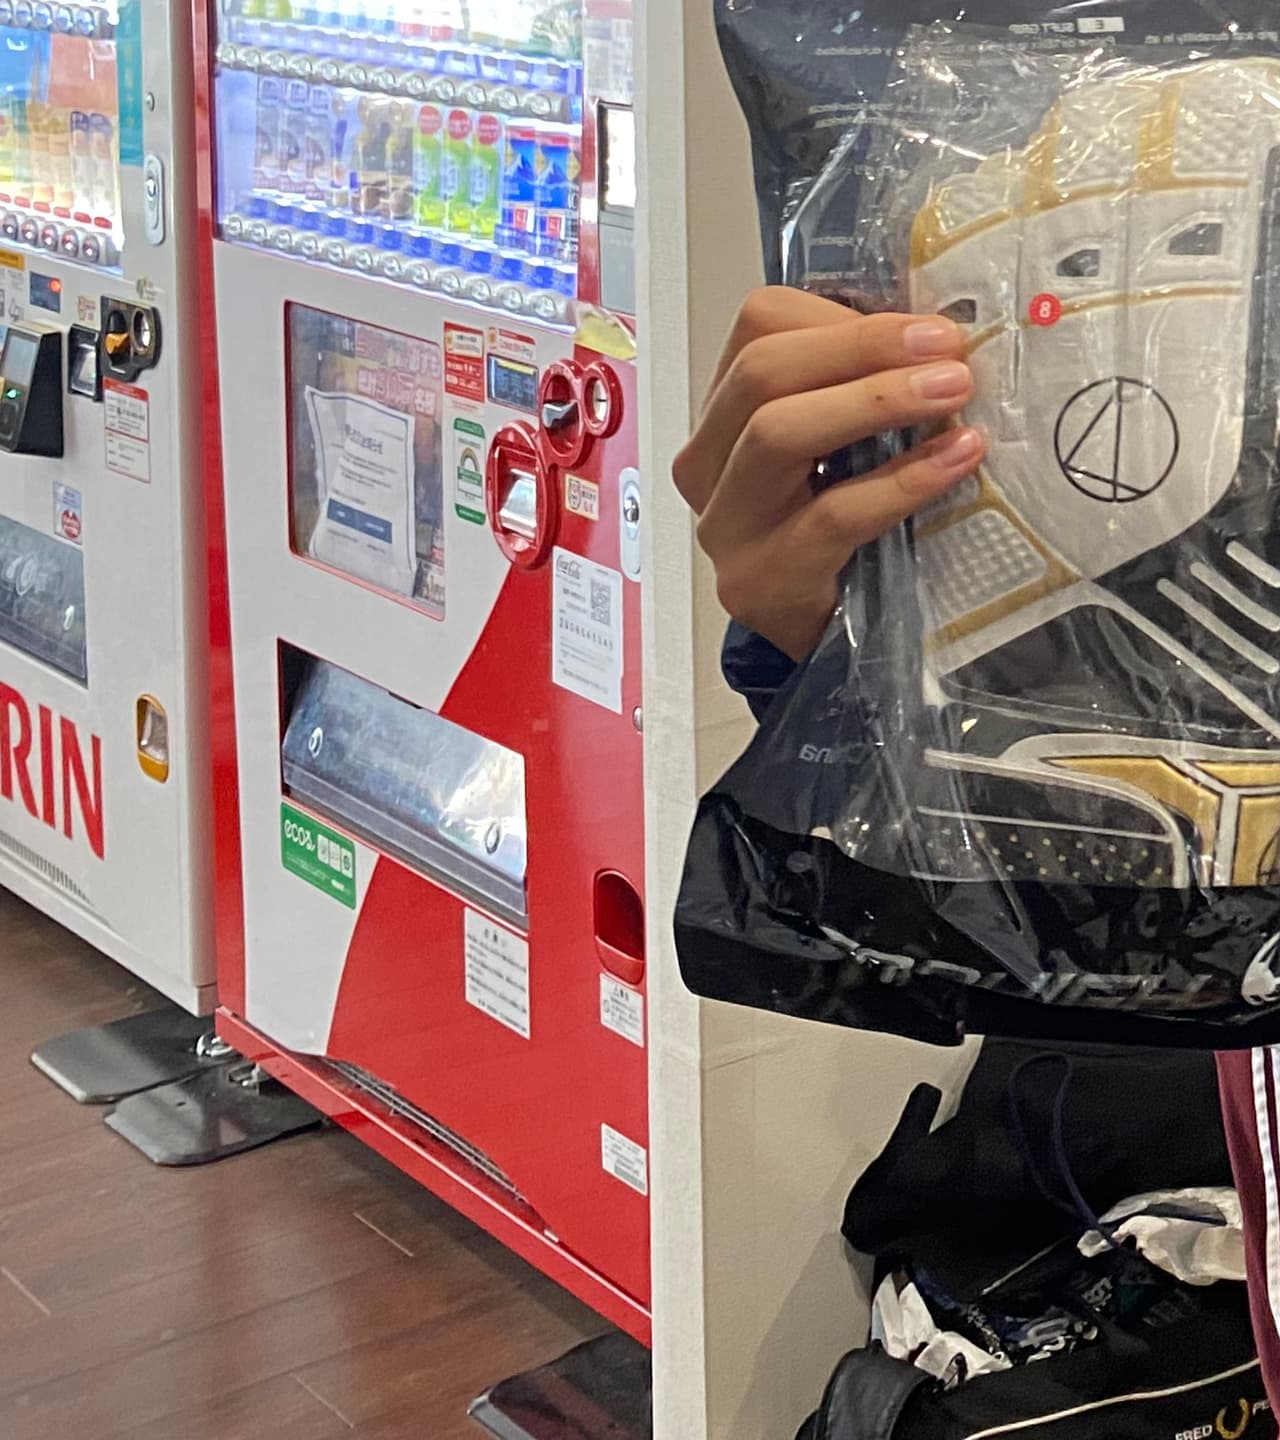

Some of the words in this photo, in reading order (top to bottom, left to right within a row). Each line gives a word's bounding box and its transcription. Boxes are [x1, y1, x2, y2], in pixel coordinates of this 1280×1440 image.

[1039, 300, 1051, 318] 8
[0, 680, 104, 861] RIN
[1175, 1424, 1213, 1440] FRED
